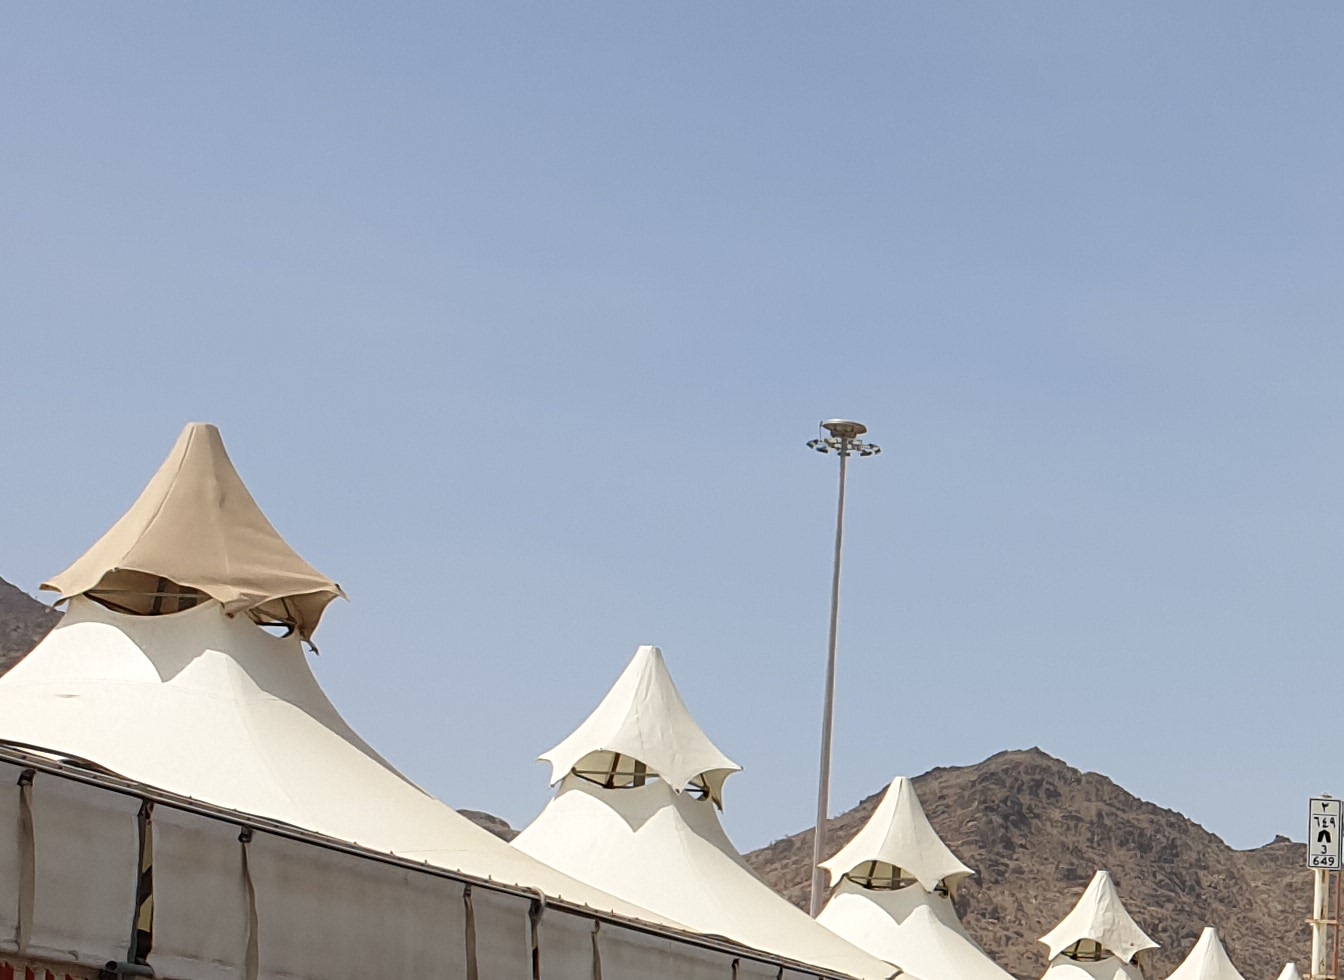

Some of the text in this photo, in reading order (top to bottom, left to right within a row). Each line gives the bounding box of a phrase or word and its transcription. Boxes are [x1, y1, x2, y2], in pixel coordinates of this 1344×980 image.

[1313, 816, 1336, 829] ٦٤٩
[1321, 844, 1328, 855] 3
[1312, 856, 1335, 866] 649
